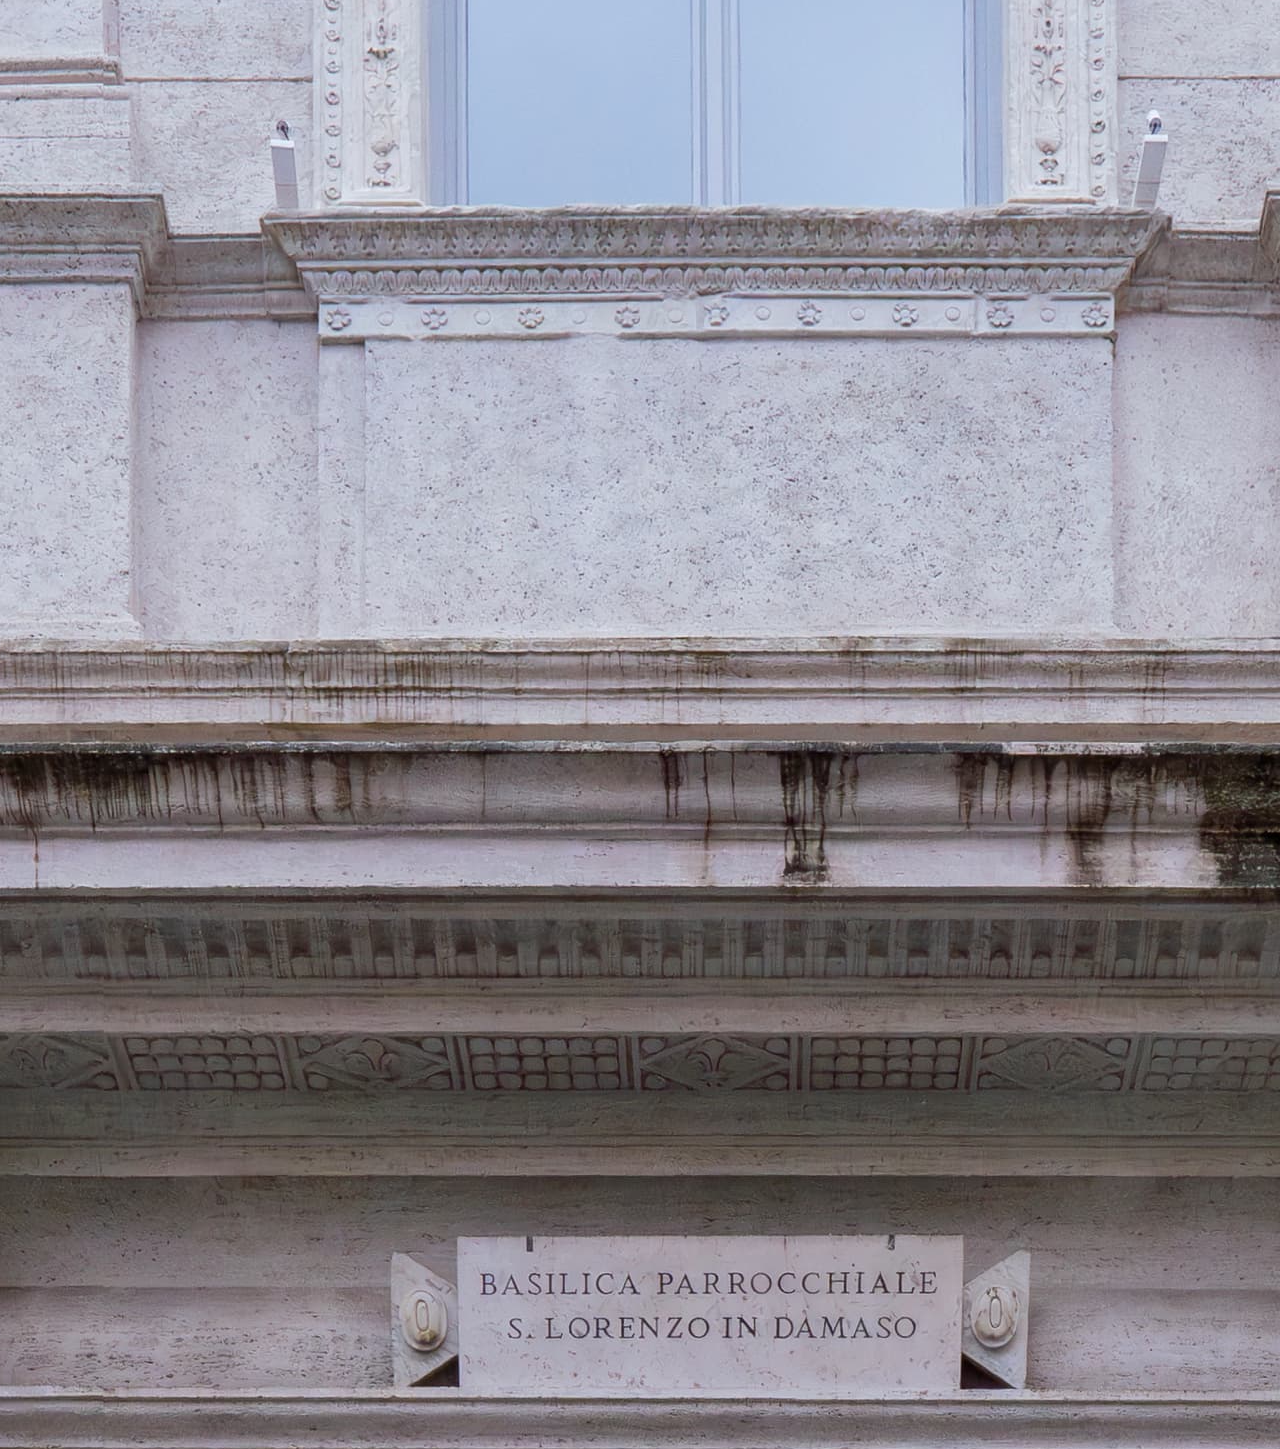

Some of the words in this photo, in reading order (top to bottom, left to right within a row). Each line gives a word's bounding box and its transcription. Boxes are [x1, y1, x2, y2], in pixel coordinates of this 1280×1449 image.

[479, 1272, 641, 1296] BASILICA
[656, 1271, 939, 1295] PARROCCHIALE
[507, 1317, 536, 1340] S.
[544, 1317, 710, 1340] LORENZO
[721, 1316, 757, 1339] IN
[773, 1315, 917, 1340] DAMASO
